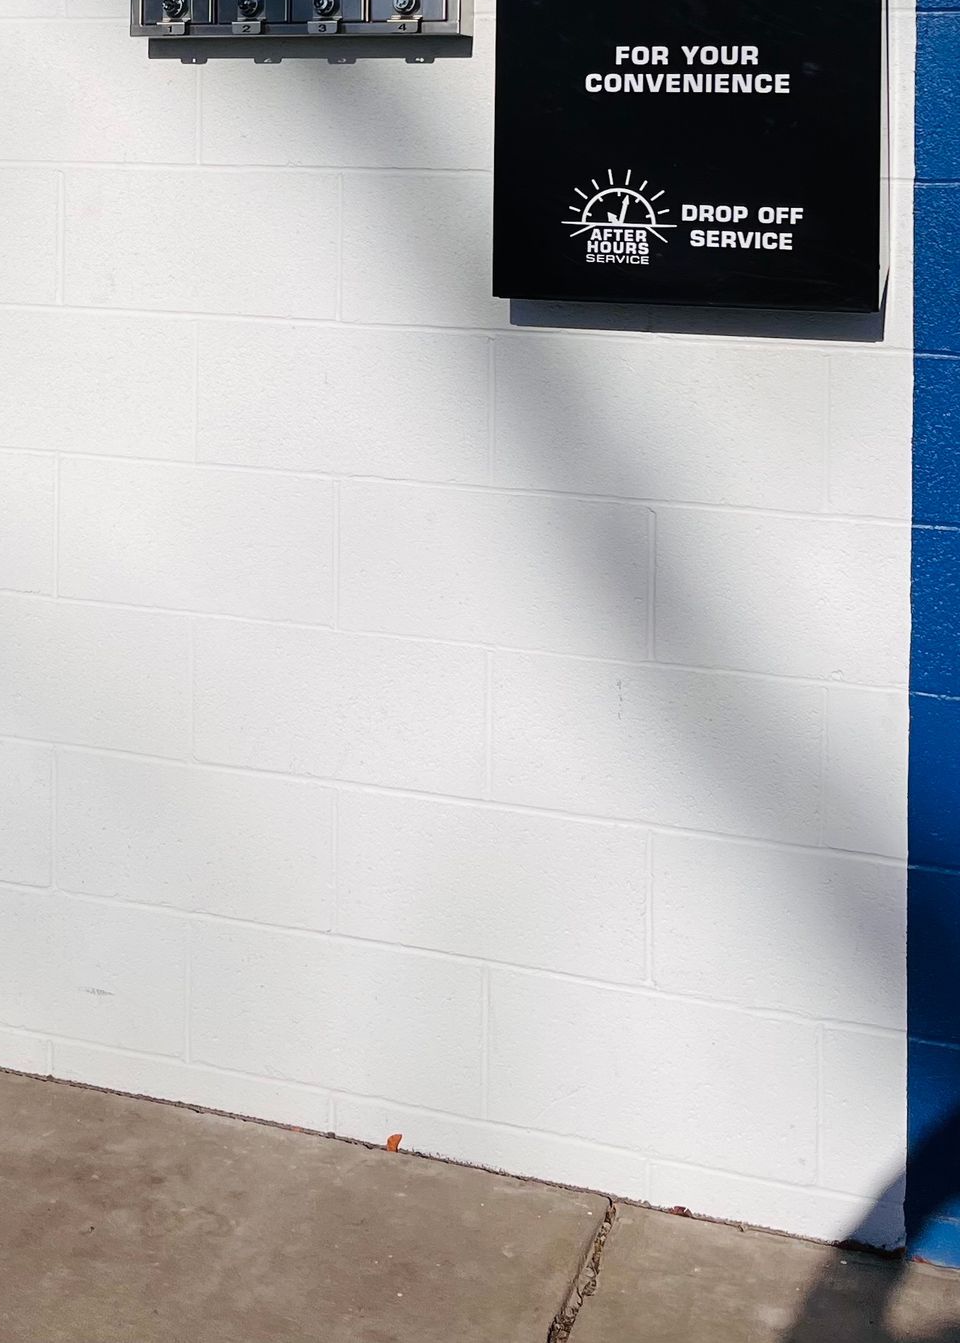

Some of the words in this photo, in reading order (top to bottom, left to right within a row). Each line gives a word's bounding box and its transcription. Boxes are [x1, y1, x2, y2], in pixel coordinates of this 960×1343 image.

[166, 25, 174, 33] 1
[242, 25, 252, 33] 2
[318, 24, 327, 33] 3
[398, 23, 408, 31] 4
[614, 45, 670, 66] FOR
[680, 45, 760, 66] YOUR
[584, 73, 791, 94] CONVENIENCE
[681, 204, 749, 223] DROP
[757, 206, 805, 225] OFF
[590, 228, 648, 242] AFTER
[689, 229, 793, 251] SERVICE
[586, 240, 650, 255] HOURS
[585, 253, 650, 265] SERVICE
